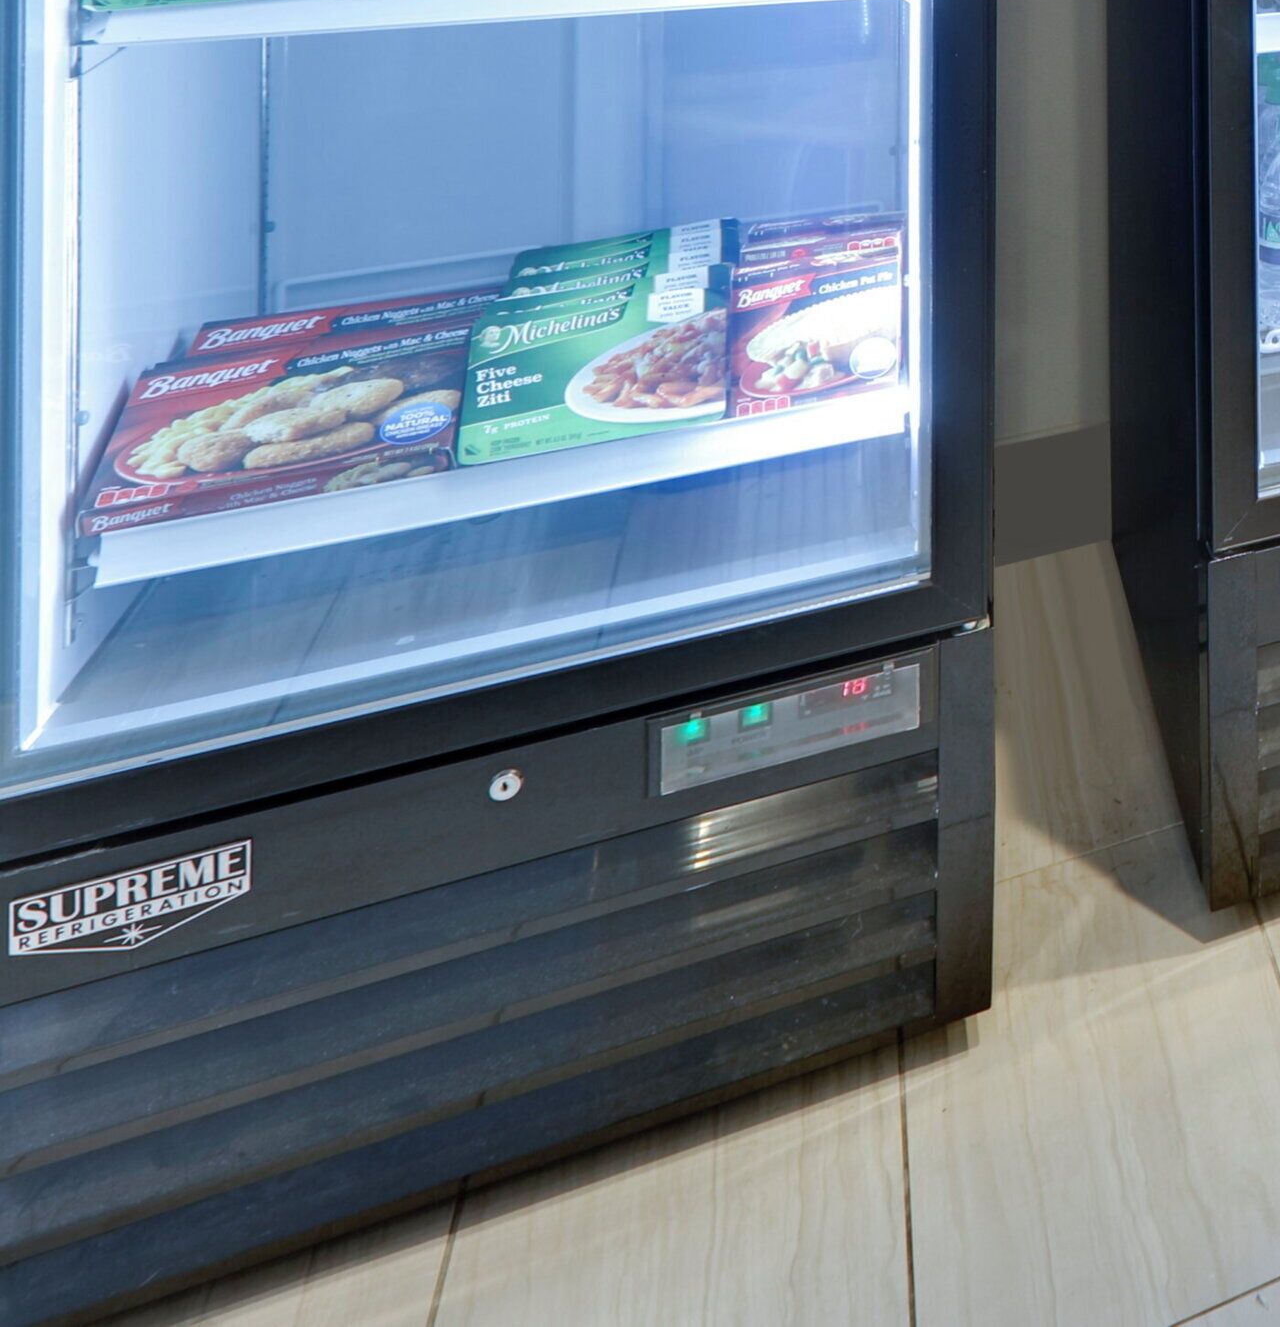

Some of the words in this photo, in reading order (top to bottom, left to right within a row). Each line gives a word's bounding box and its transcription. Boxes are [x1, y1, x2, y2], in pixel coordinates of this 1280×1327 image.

[738, 278, 807, 311] Banquet
[819, 278, 858, 295] Chicken
[198, 314, 327, 351] Banquet
[341, 312, 381, 327] Chicken
[382, 307, 420, 324] Nuggets
[435, 300, 455, 313] Mac
[500, 308, 622, 354] Michelina's
[140, 357, 279, 401] Banquet
[296, 350, 341, 369] Chicken
[342, 342, 382, 361] Nuggets
[400, 336, 421, 350] Mac
[434, 327, 469, 342] Cheese
[475, 363, 517, 383] Five
[475, 371, 543, 394] Cheese
[476, 391, 512, 409] Ziti
[384, 414, 448, 432] NATURAL
[503, 413, 551, 431] PROTEIN
[91, 499, 176, 533] Banquet
[16, 842, 248, 935] SUPREME
[18, 876, 245, 954] REFRIGERATION
